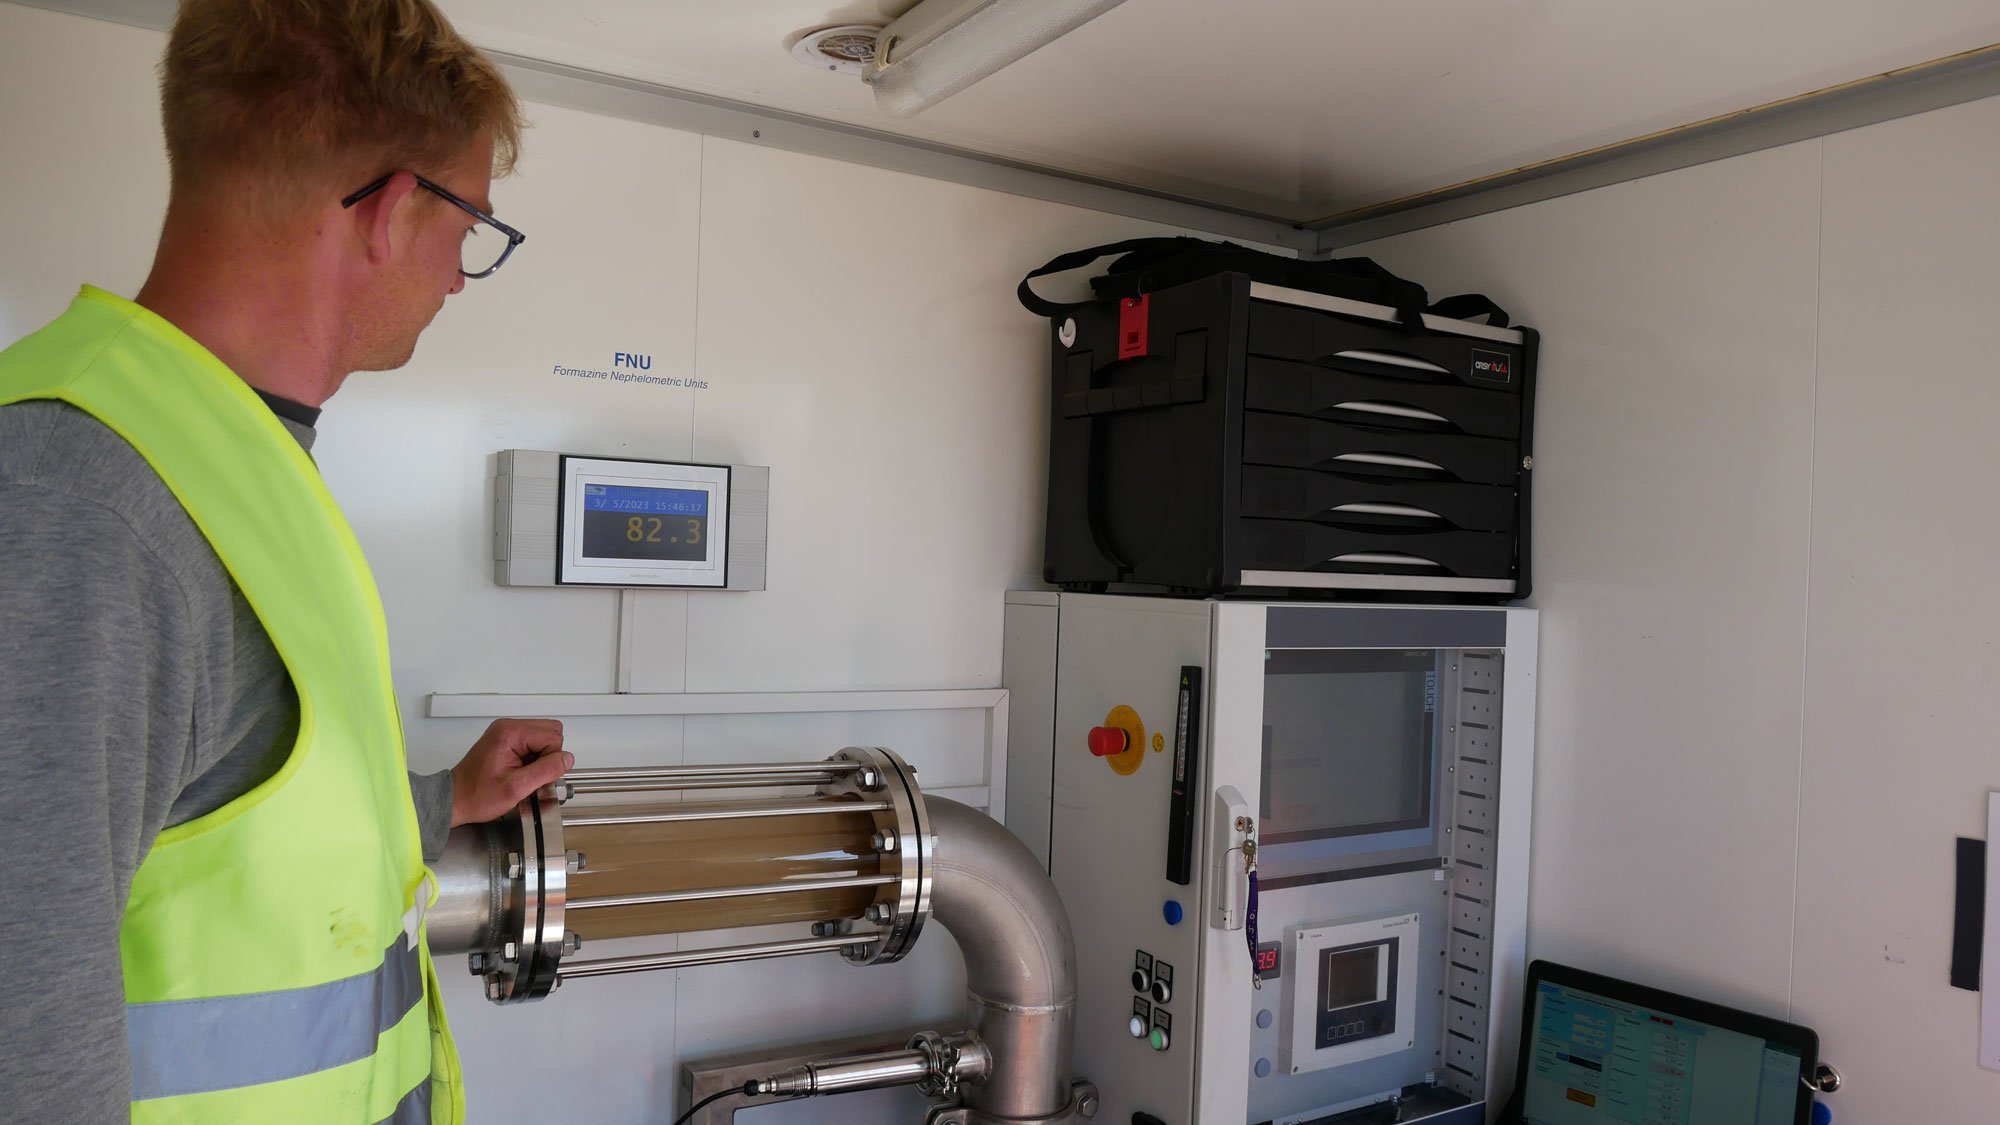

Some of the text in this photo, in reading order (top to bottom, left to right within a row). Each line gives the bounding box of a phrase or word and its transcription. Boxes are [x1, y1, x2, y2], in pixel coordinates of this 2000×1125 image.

[614, 352, 652, 370] FNU
[553, 365, 709, 390] Formazine Nephelometric Units
[655, 501, 702, 512] 15:46:17
[626, 516, 702, 544] 82.3
[1425, 672, 1436, 711] TOUCH
